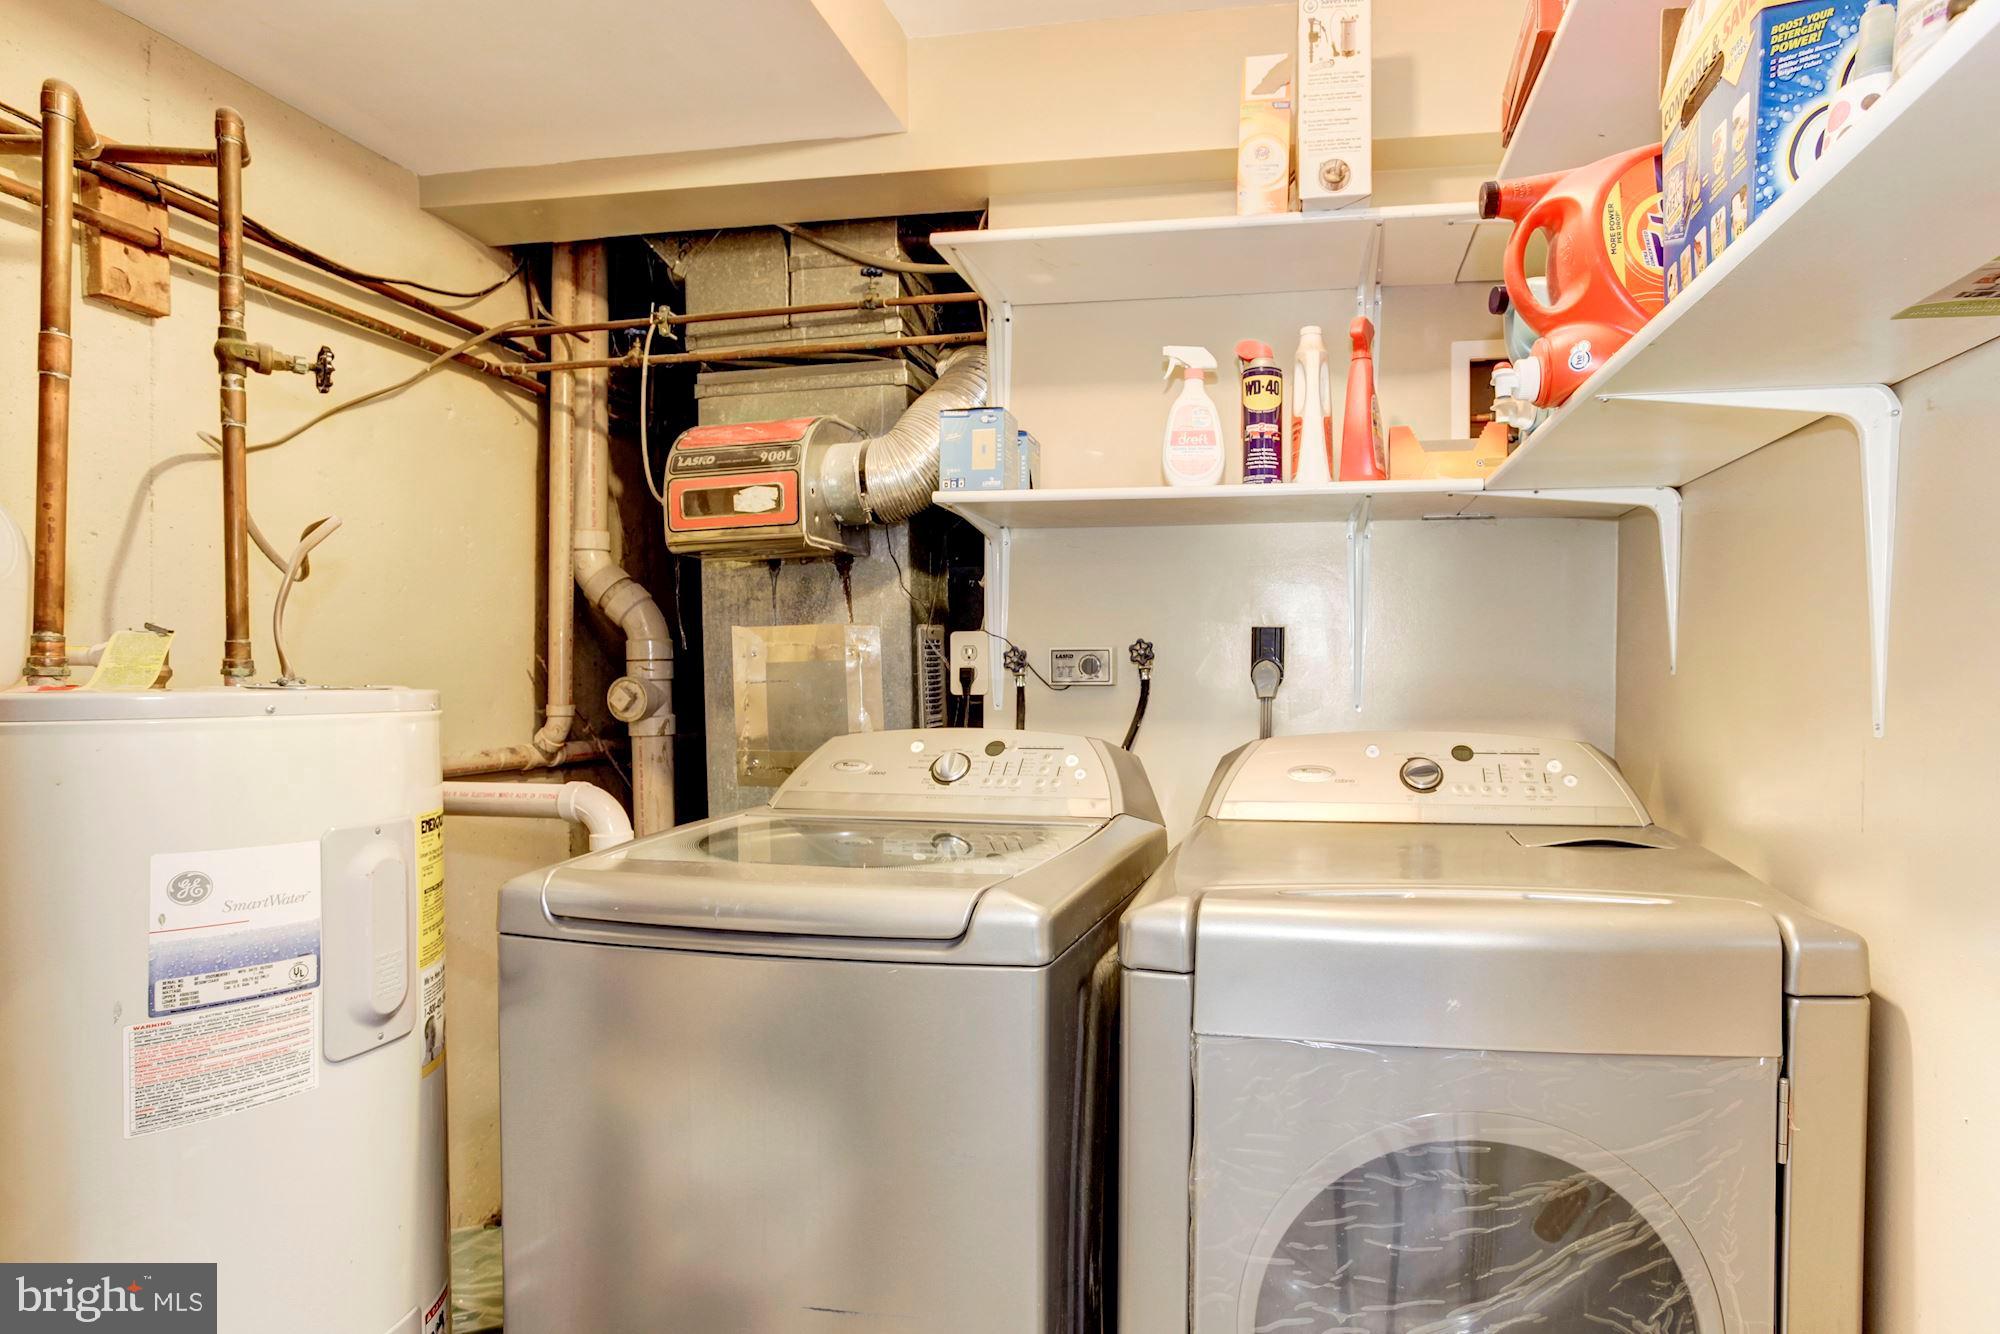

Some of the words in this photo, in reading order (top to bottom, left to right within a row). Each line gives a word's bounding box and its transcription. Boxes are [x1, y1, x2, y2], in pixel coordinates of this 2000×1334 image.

[1770, 18, 1828, 45] DETERGENT
[1771, 17, 1805, 35] BOOST
[1807, 7, 1835, 23] YOUR
[1770, 30, 1823, 56] POWER!
[1664, 47, 1709, 131] COMPARE
[1607, 203, 1615, 231] POWER
[1245, 380, 1280, 396] WD-40
[1178, 432, 1208, 445] dreft
[678, 456, 715, 467] LASKO
[760, 450, 794, 462] 900L
[222, 892, 308, 913] SmartWater
[284, 992, 313, 1001] CAUTION
[133, 1020, 172, 1031] WARNING
